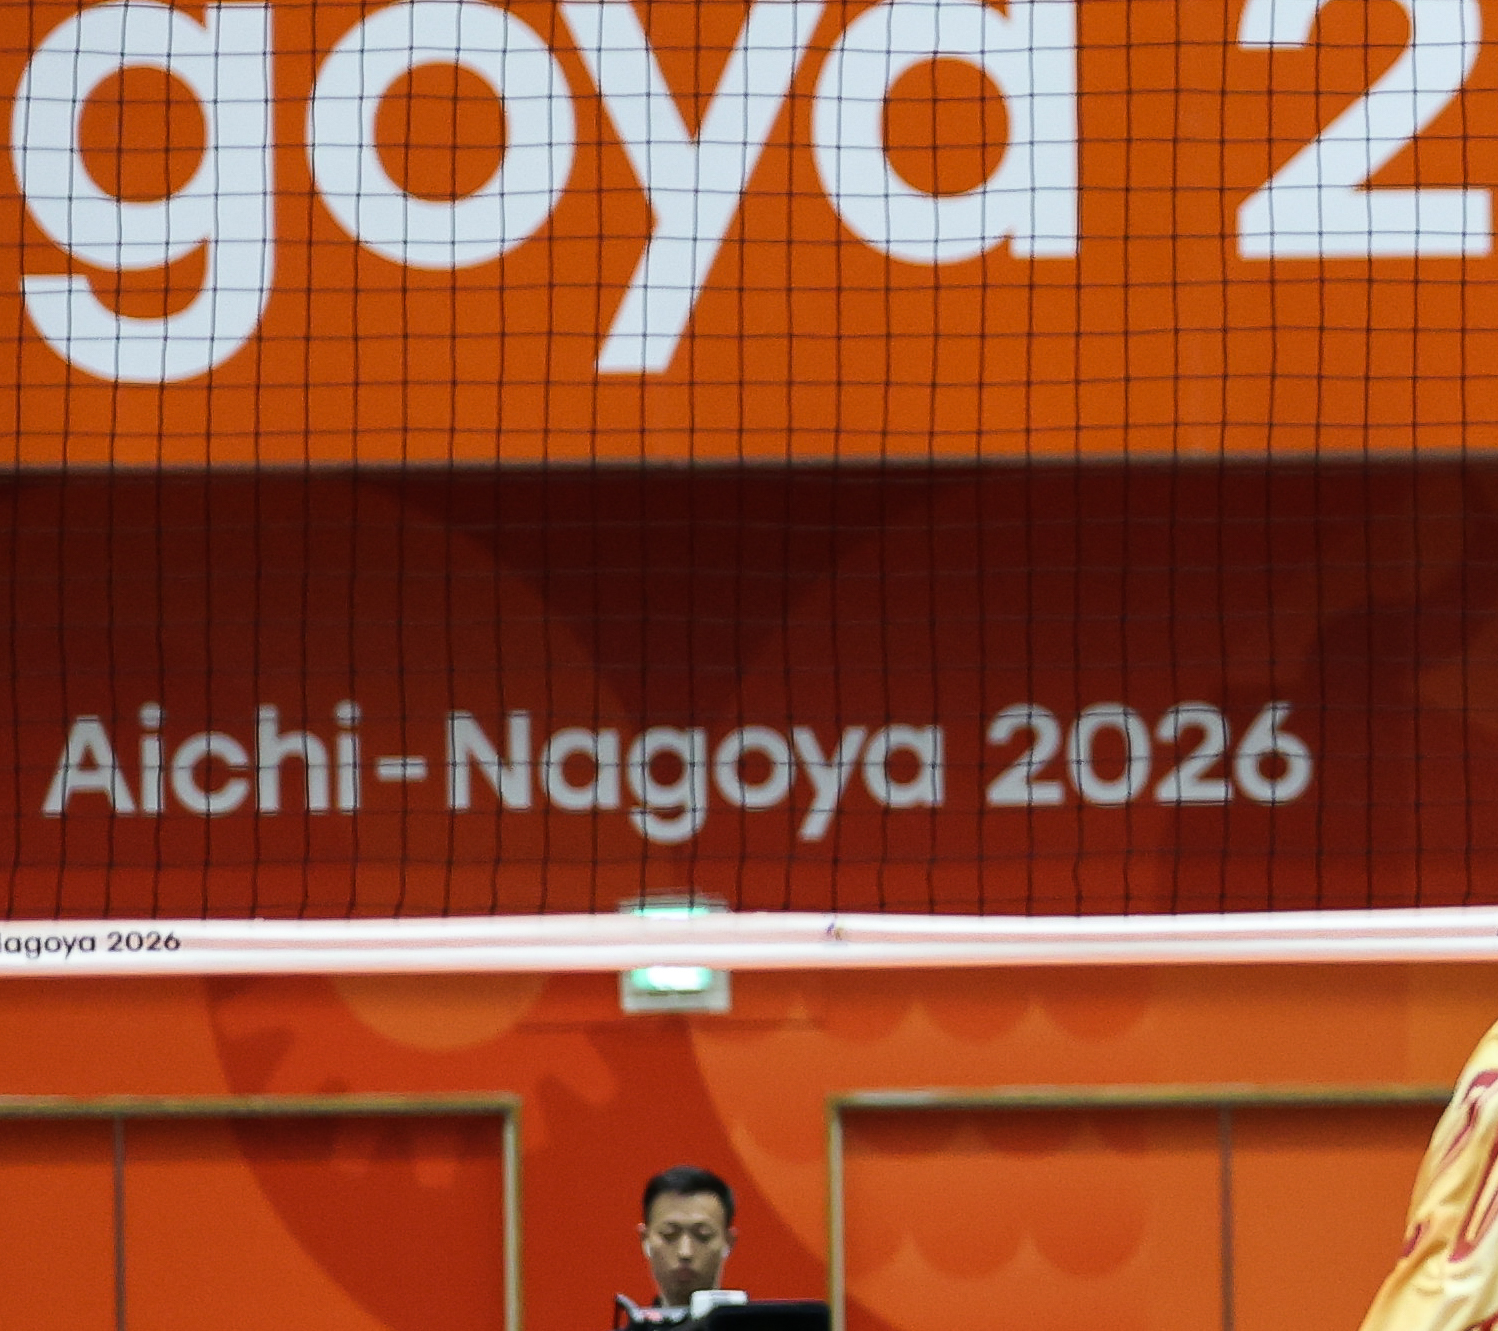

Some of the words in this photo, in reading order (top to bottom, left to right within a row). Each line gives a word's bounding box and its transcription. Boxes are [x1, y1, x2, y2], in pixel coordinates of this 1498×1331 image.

[42, 702, 943, 842] Aichi-Nagoya
[985, 702, 1314, 807] 2026
[4, 935, 96, 960] agoya
[107, 931, 181, 953] 2026
